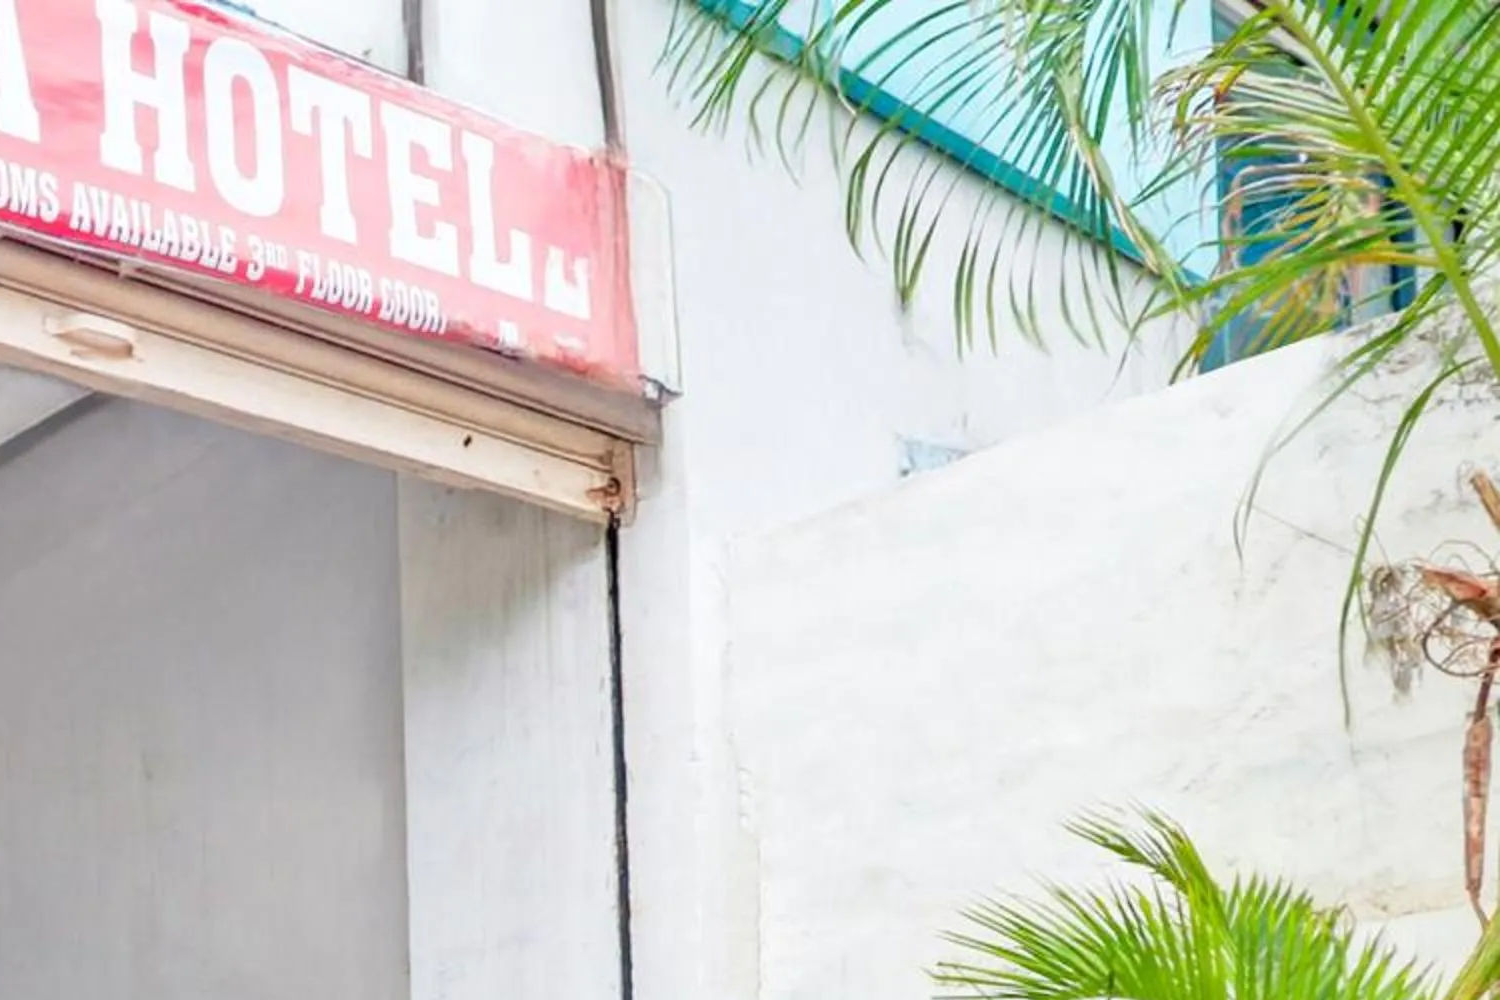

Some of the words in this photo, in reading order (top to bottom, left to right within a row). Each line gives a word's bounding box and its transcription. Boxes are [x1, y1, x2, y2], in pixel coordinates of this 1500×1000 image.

[69, 181, 238, 275] AVAILABLE
[294, 247, 374, 315] FLOOR
[94, 0, 534, 302] HOTEL
